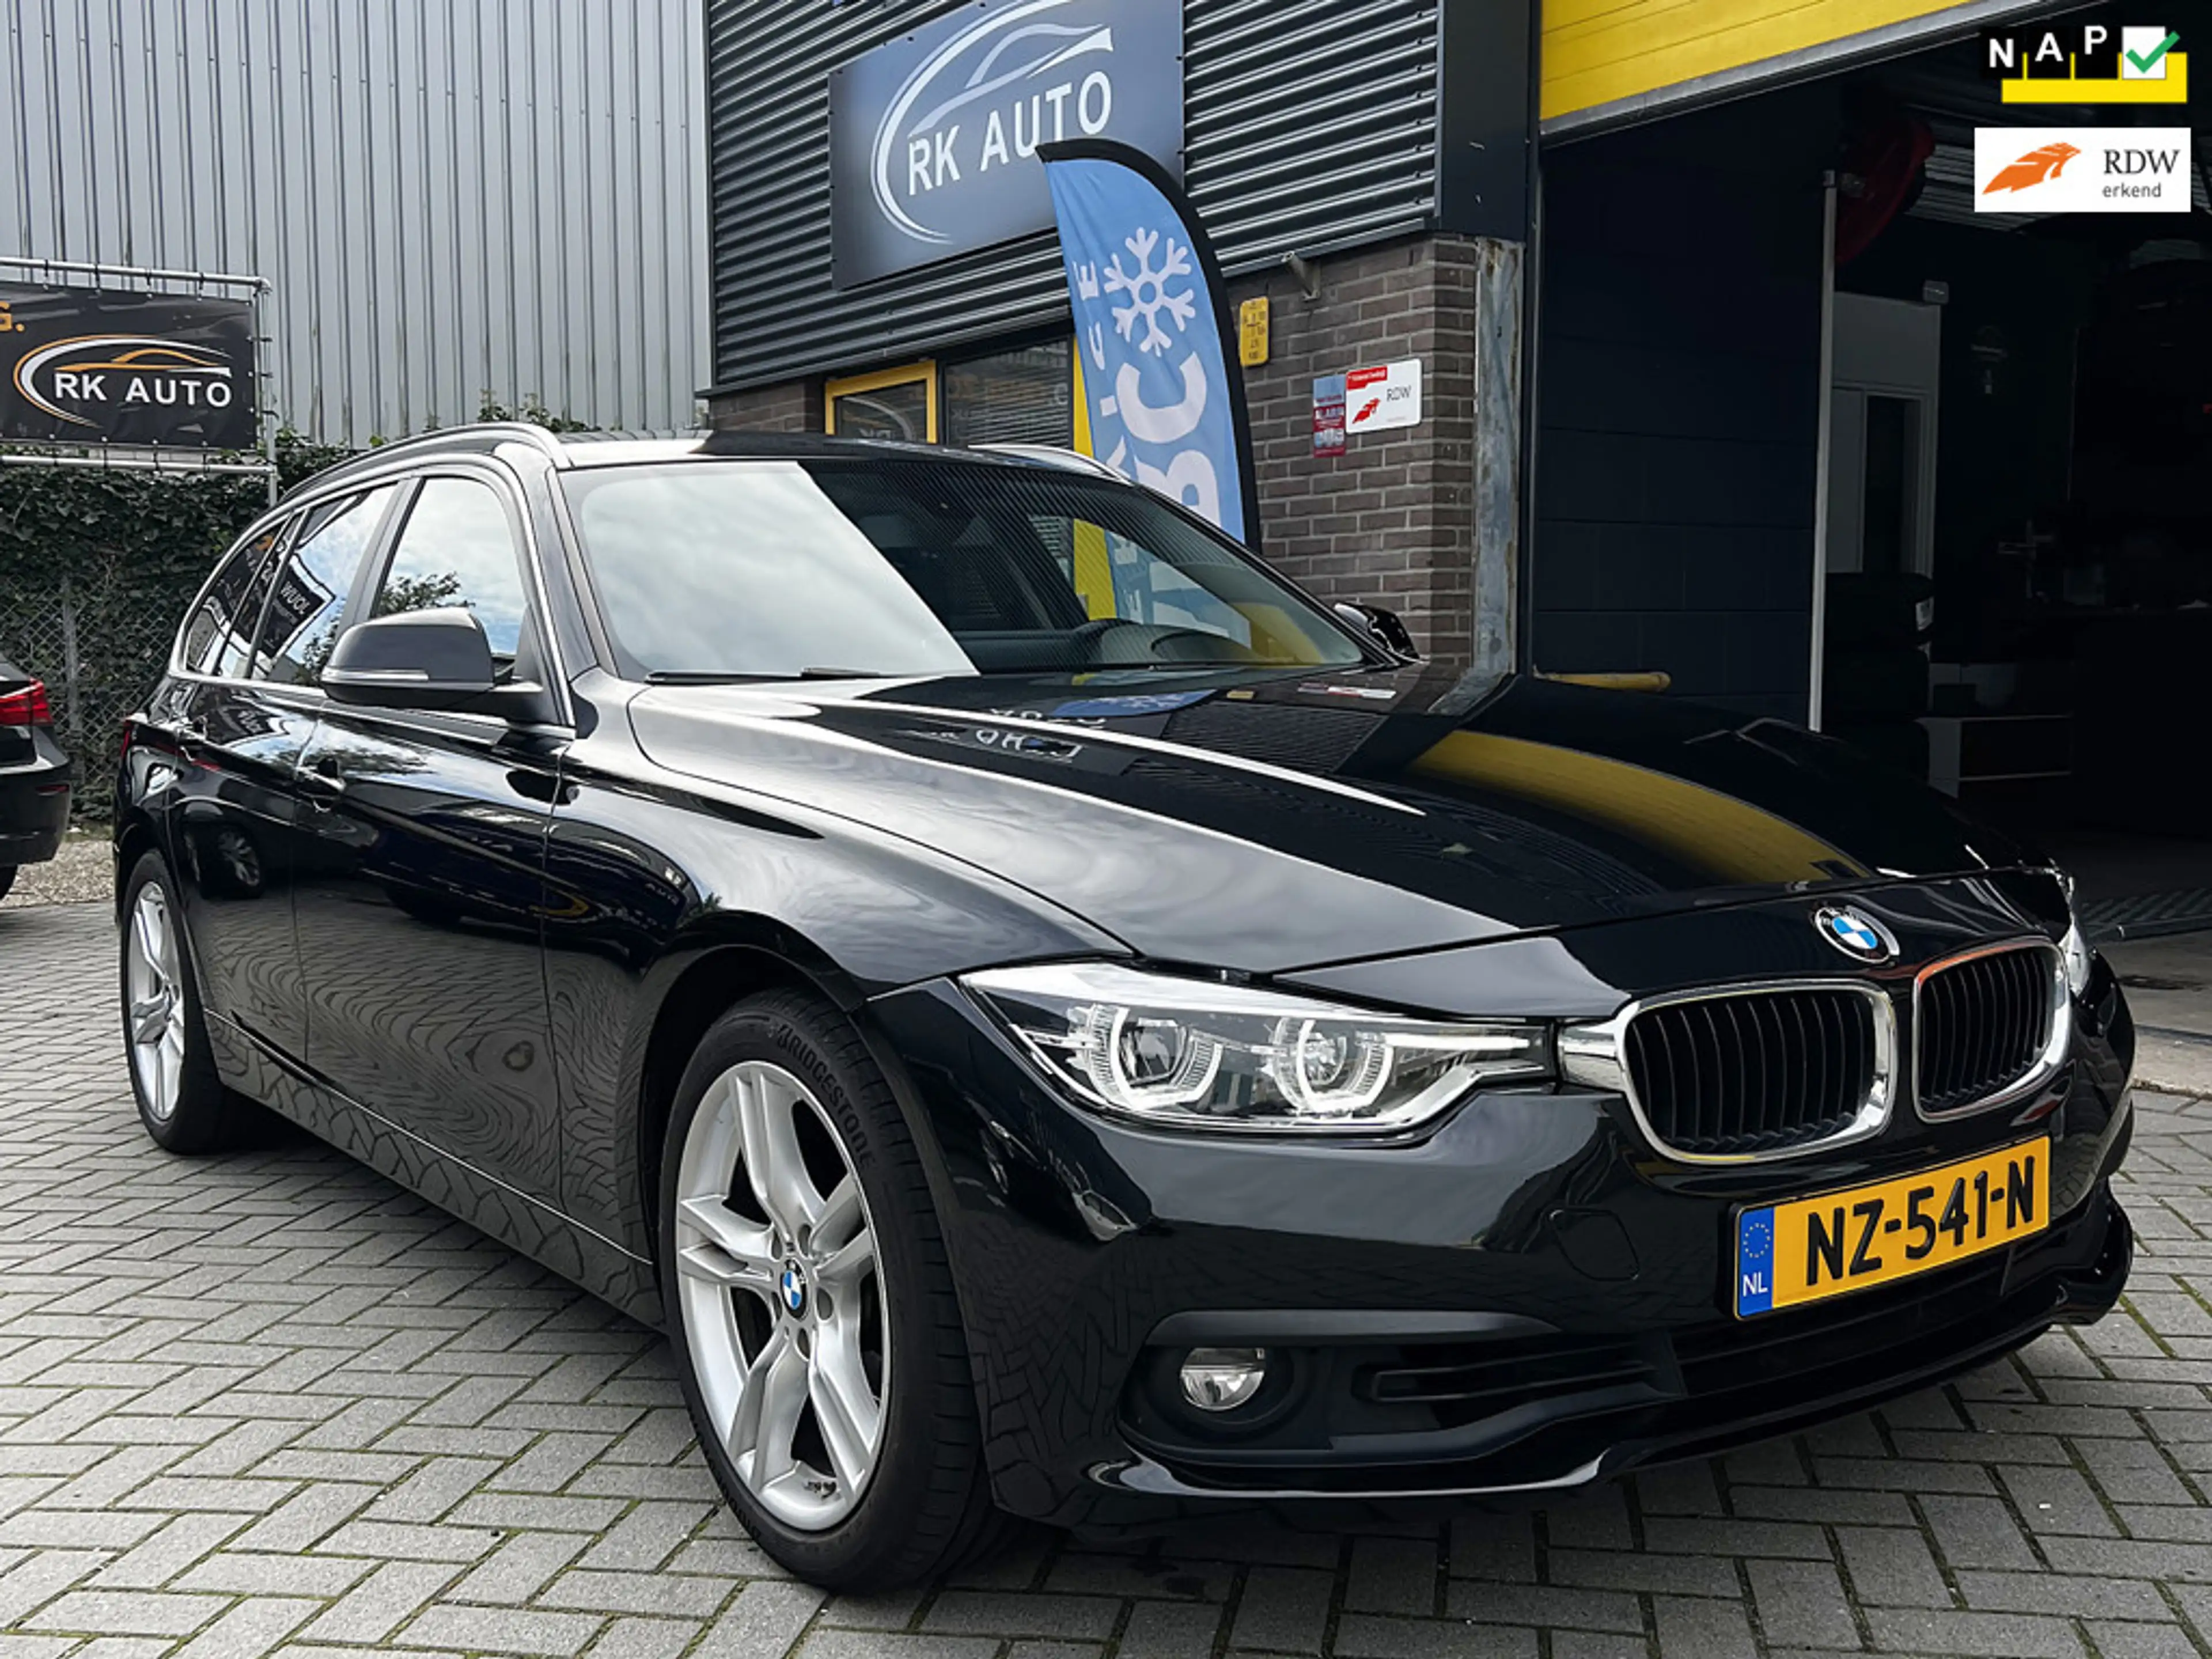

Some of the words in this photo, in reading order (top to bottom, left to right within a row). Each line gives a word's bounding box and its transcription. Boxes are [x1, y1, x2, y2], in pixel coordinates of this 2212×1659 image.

[908, 125, 961, 196] RK
[980, 70, 1112, 172] AUTO
[54, 373, 108, 401] RK
[125, 378, 231, 408] AUTO
[1806, 1155, 2036, 1286] NZ-541-N
[1742, 1272, 1768, 1297] NL
